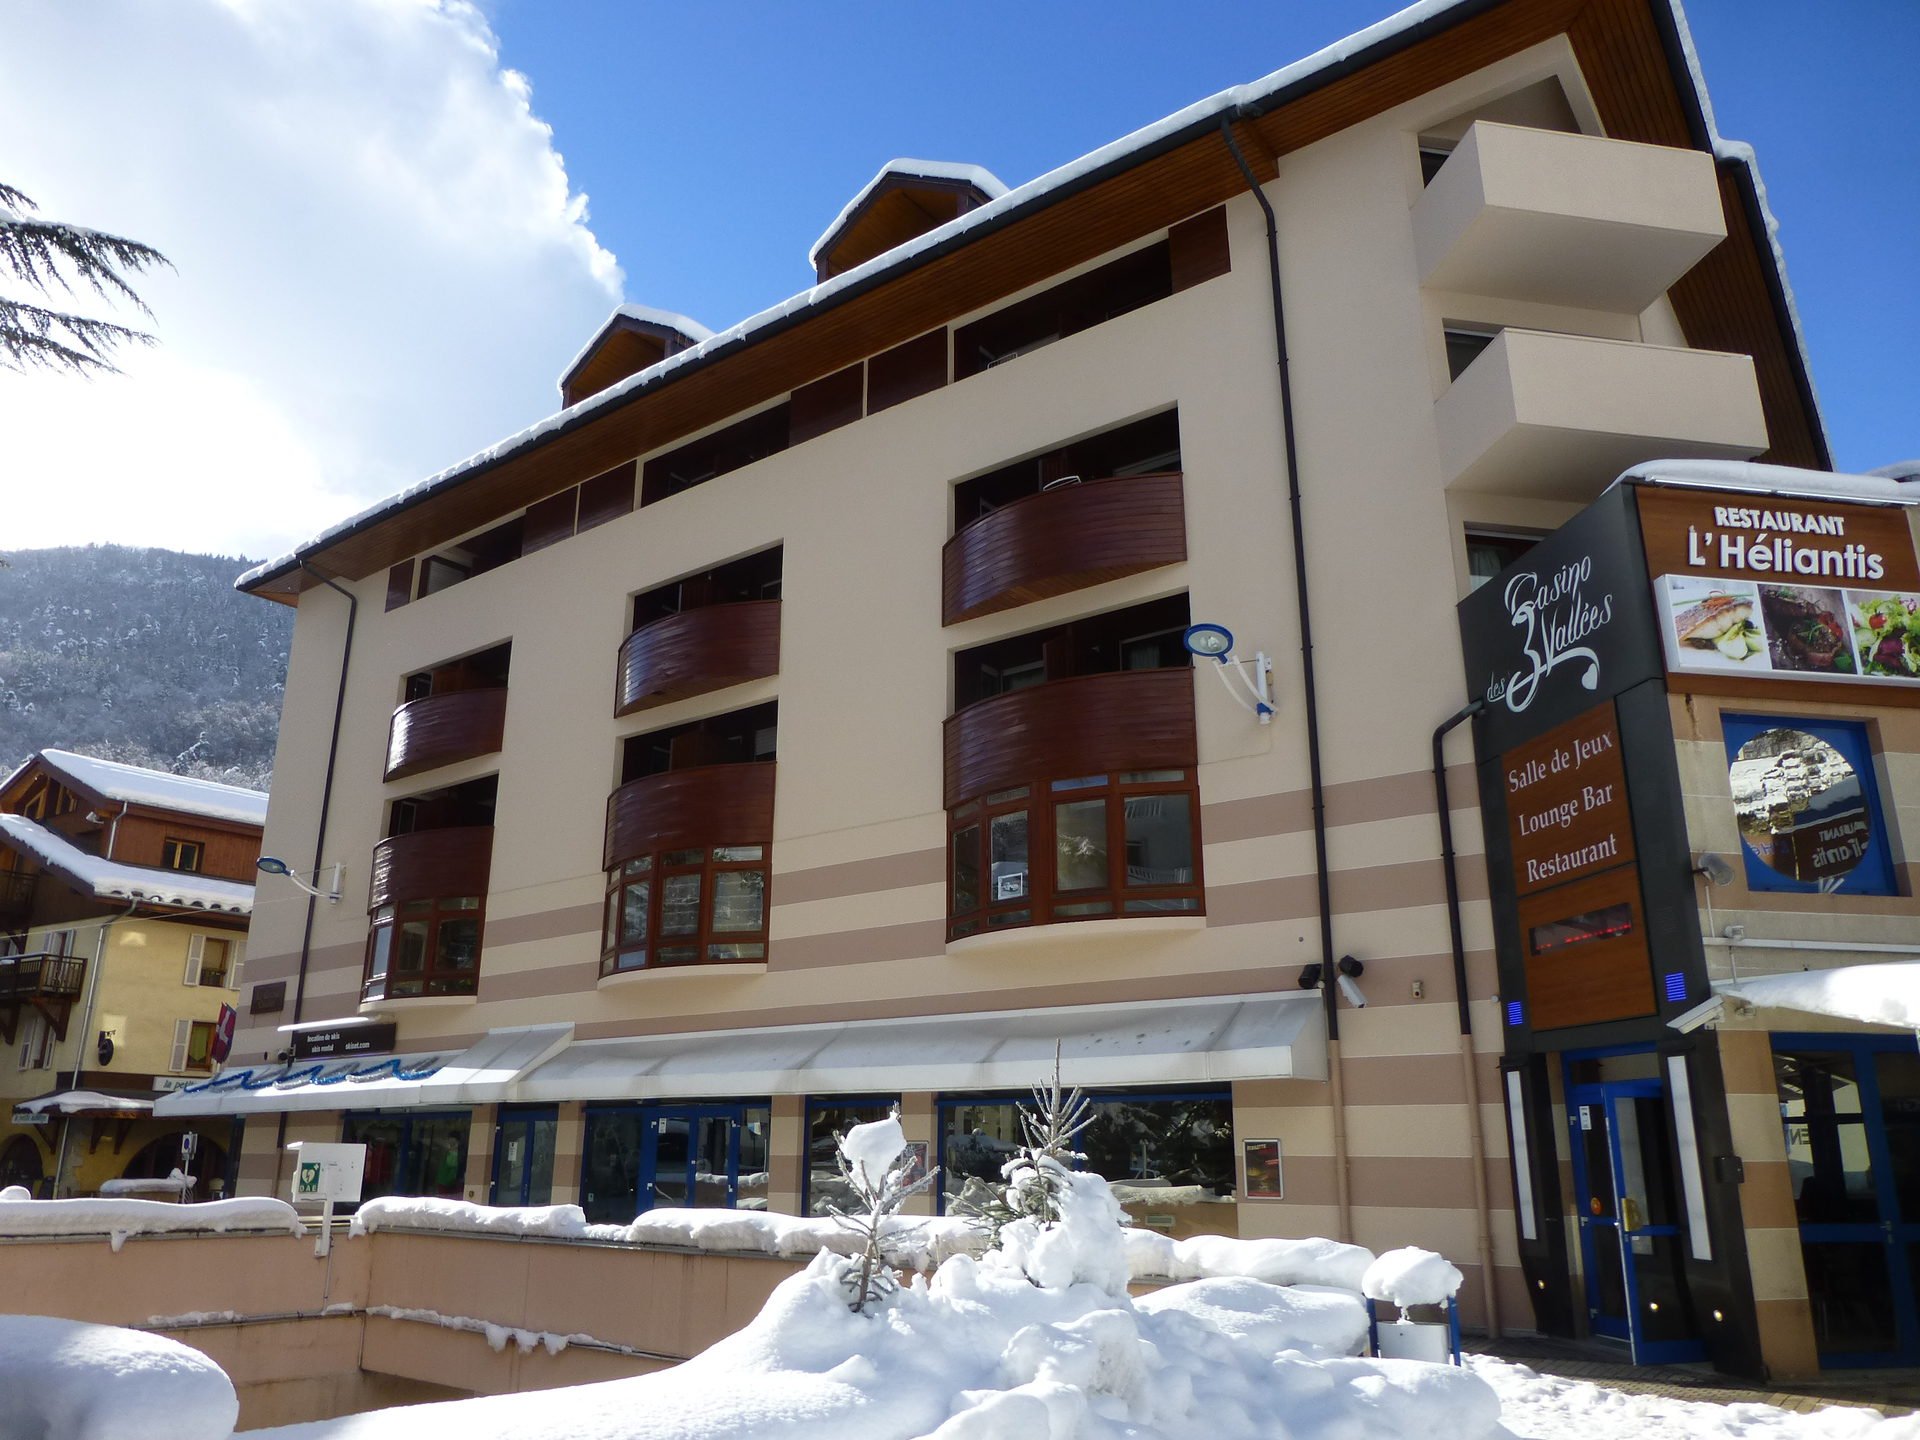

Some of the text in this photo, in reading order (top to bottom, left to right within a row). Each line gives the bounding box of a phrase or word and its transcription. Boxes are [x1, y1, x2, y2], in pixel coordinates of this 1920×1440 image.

[1714, 506, 1845, 536] RESTAURANT
[1504, 555, 1591, 615] Casino
[1487, 671, 1505, 702] des
[1541, 591, 1612, 677] Vallées
[1508, 730, 1613, 793] Salle de Jeux
[1518, 785, 1613, 837] Lounge Bar
[1526, 832, 1618, 883] Restaurant
[299, 1184, 317, 1192] DAE
